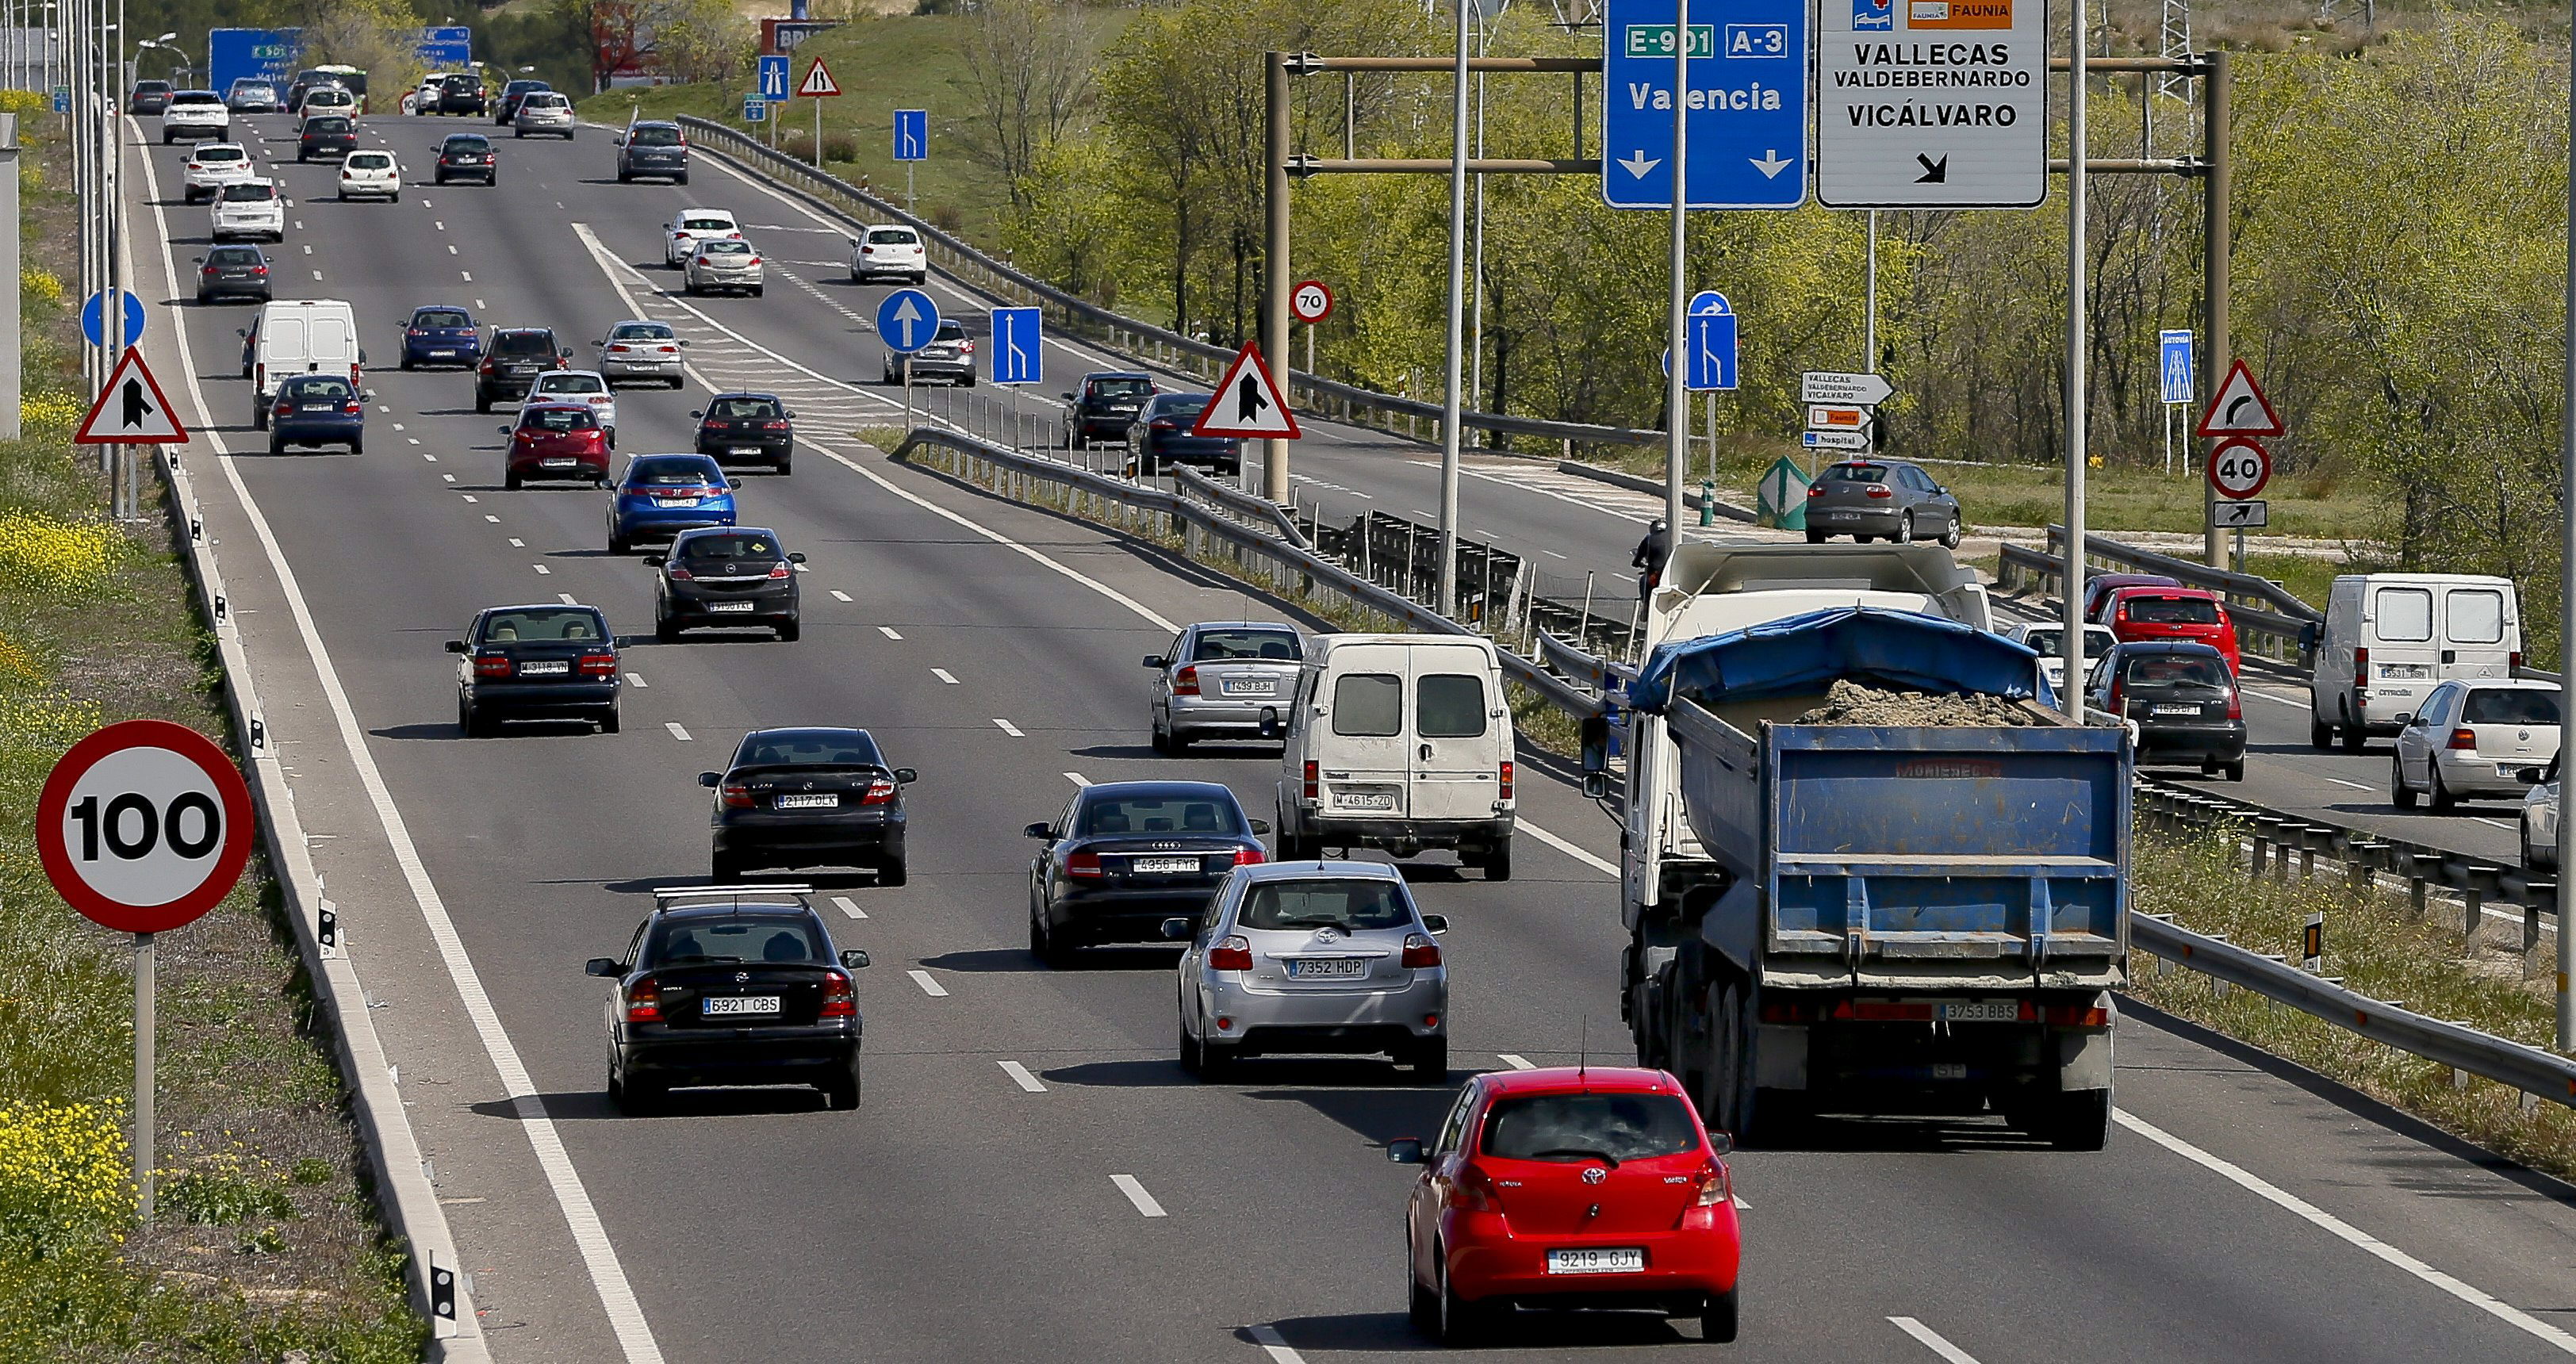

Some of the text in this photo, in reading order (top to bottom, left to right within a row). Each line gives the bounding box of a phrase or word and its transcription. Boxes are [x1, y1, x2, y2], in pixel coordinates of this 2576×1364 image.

[1953, 4, 2009, 17] FAUNIA
[1732, 30, 1783, 53] A-3
[1854, 44, 2009, 66] VALLECAS
[1834, 71, 2031, 87] VALDEBERNARDO
[1629, 82, 1781, 110] Vaencia
[1847, 98, 2018, 127] VICÁLVARO
[1300, 295, 1321, 308] 70
[1809, 374, 1852, 383] VALLECAS
[1821, 435, 1856, 445] hospital
[2221, 458, 2258, 479] 40
[785, 795, 813, 806] 2117
[71, 791, 220, 862] 100
[1175, 858, 1196, 870] FYR
[1298, 960, 1361, 974] 7352 HDP
[712, 998, 777, 1012] 6921 CBS
[1949, 1005, 2014, 1018] 3753 BBS
[1559, 1251, 1637, 1267] 9219 GJY
